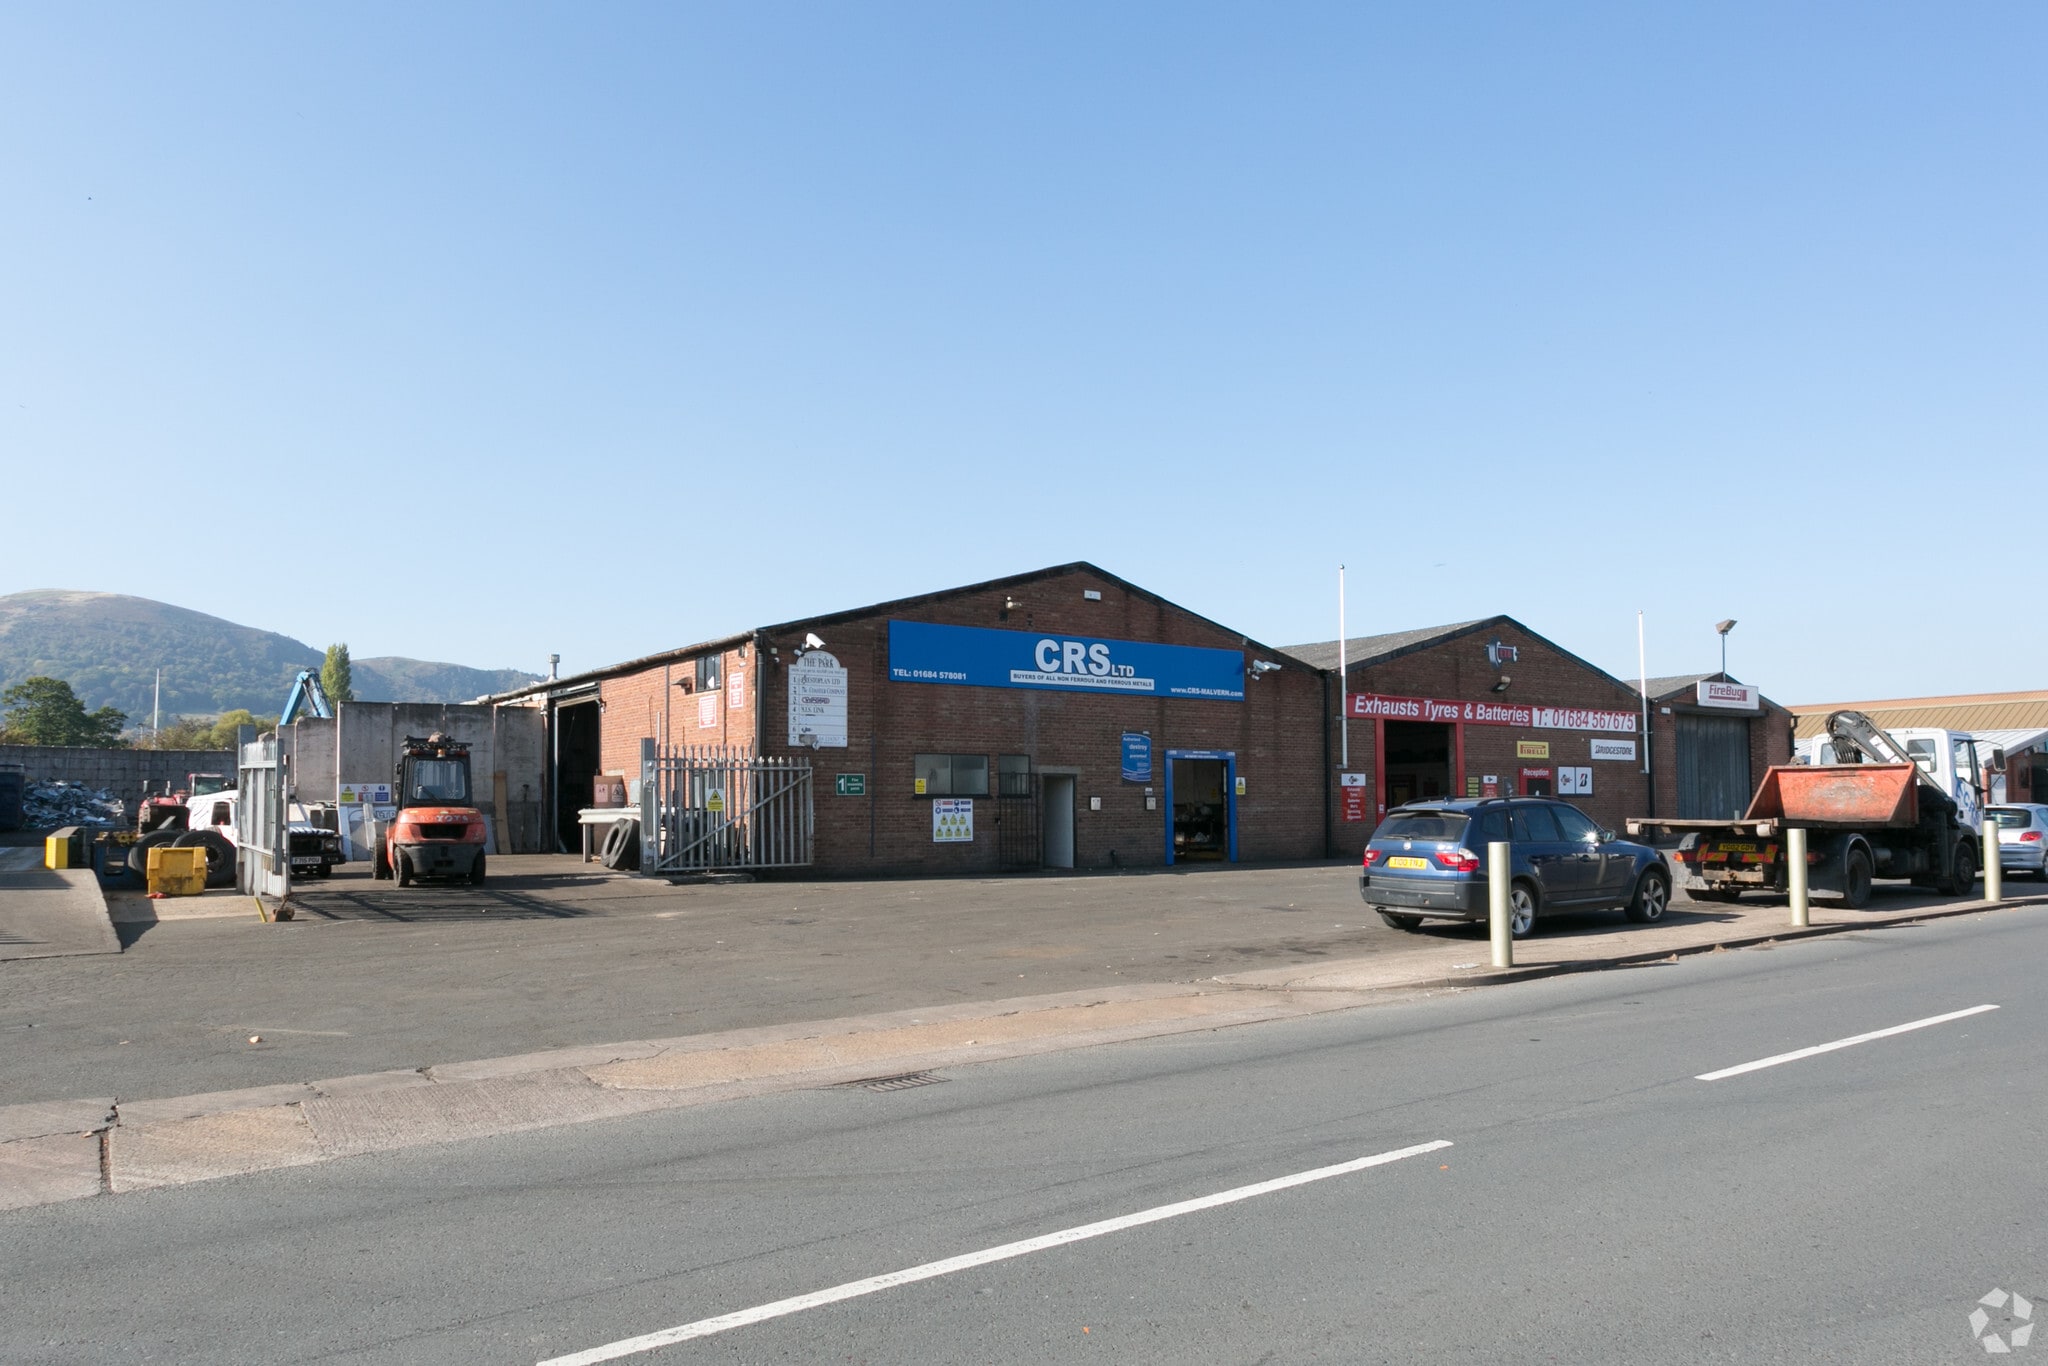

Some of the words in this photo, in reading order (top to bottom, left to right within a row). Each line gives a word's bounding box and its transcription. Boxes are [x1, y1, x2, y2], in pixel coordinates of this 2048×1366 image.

[803, 658, 817, 668] THE
[818, 657, 834, 669] PARK
[1035, 639, 1111, 676] CRS
[1111, 664, 1134, 677] LTD
[893, 668, 911, 677] TEL:
[913, 670, 937, 678] 01684
[939, 671, 967, 680] 578081
[1171, 687, 1243, 697] www.CRS-MALVERN.com
[1709, 684, 1742, 698] FireBug
[1354, 695, 1419, 717] Exhausts
[1424, 700, 1459, 721] Tyres
[1463, 703, 1473, 719] &
[1476, 703, 1529, 722] Batteries
[1537, 708, 1548, 726] T:
[1552, 708, 1589, 728] 01684
[1592, 711, 1634, 730] 567675
[1520, 744, 1546, 755] PIRELLI
[1594, 744, 1633, 755] BRIDGESTONE
[1522, 768, 1549, 777] Reception
[838, 777, 845, 792] 1
